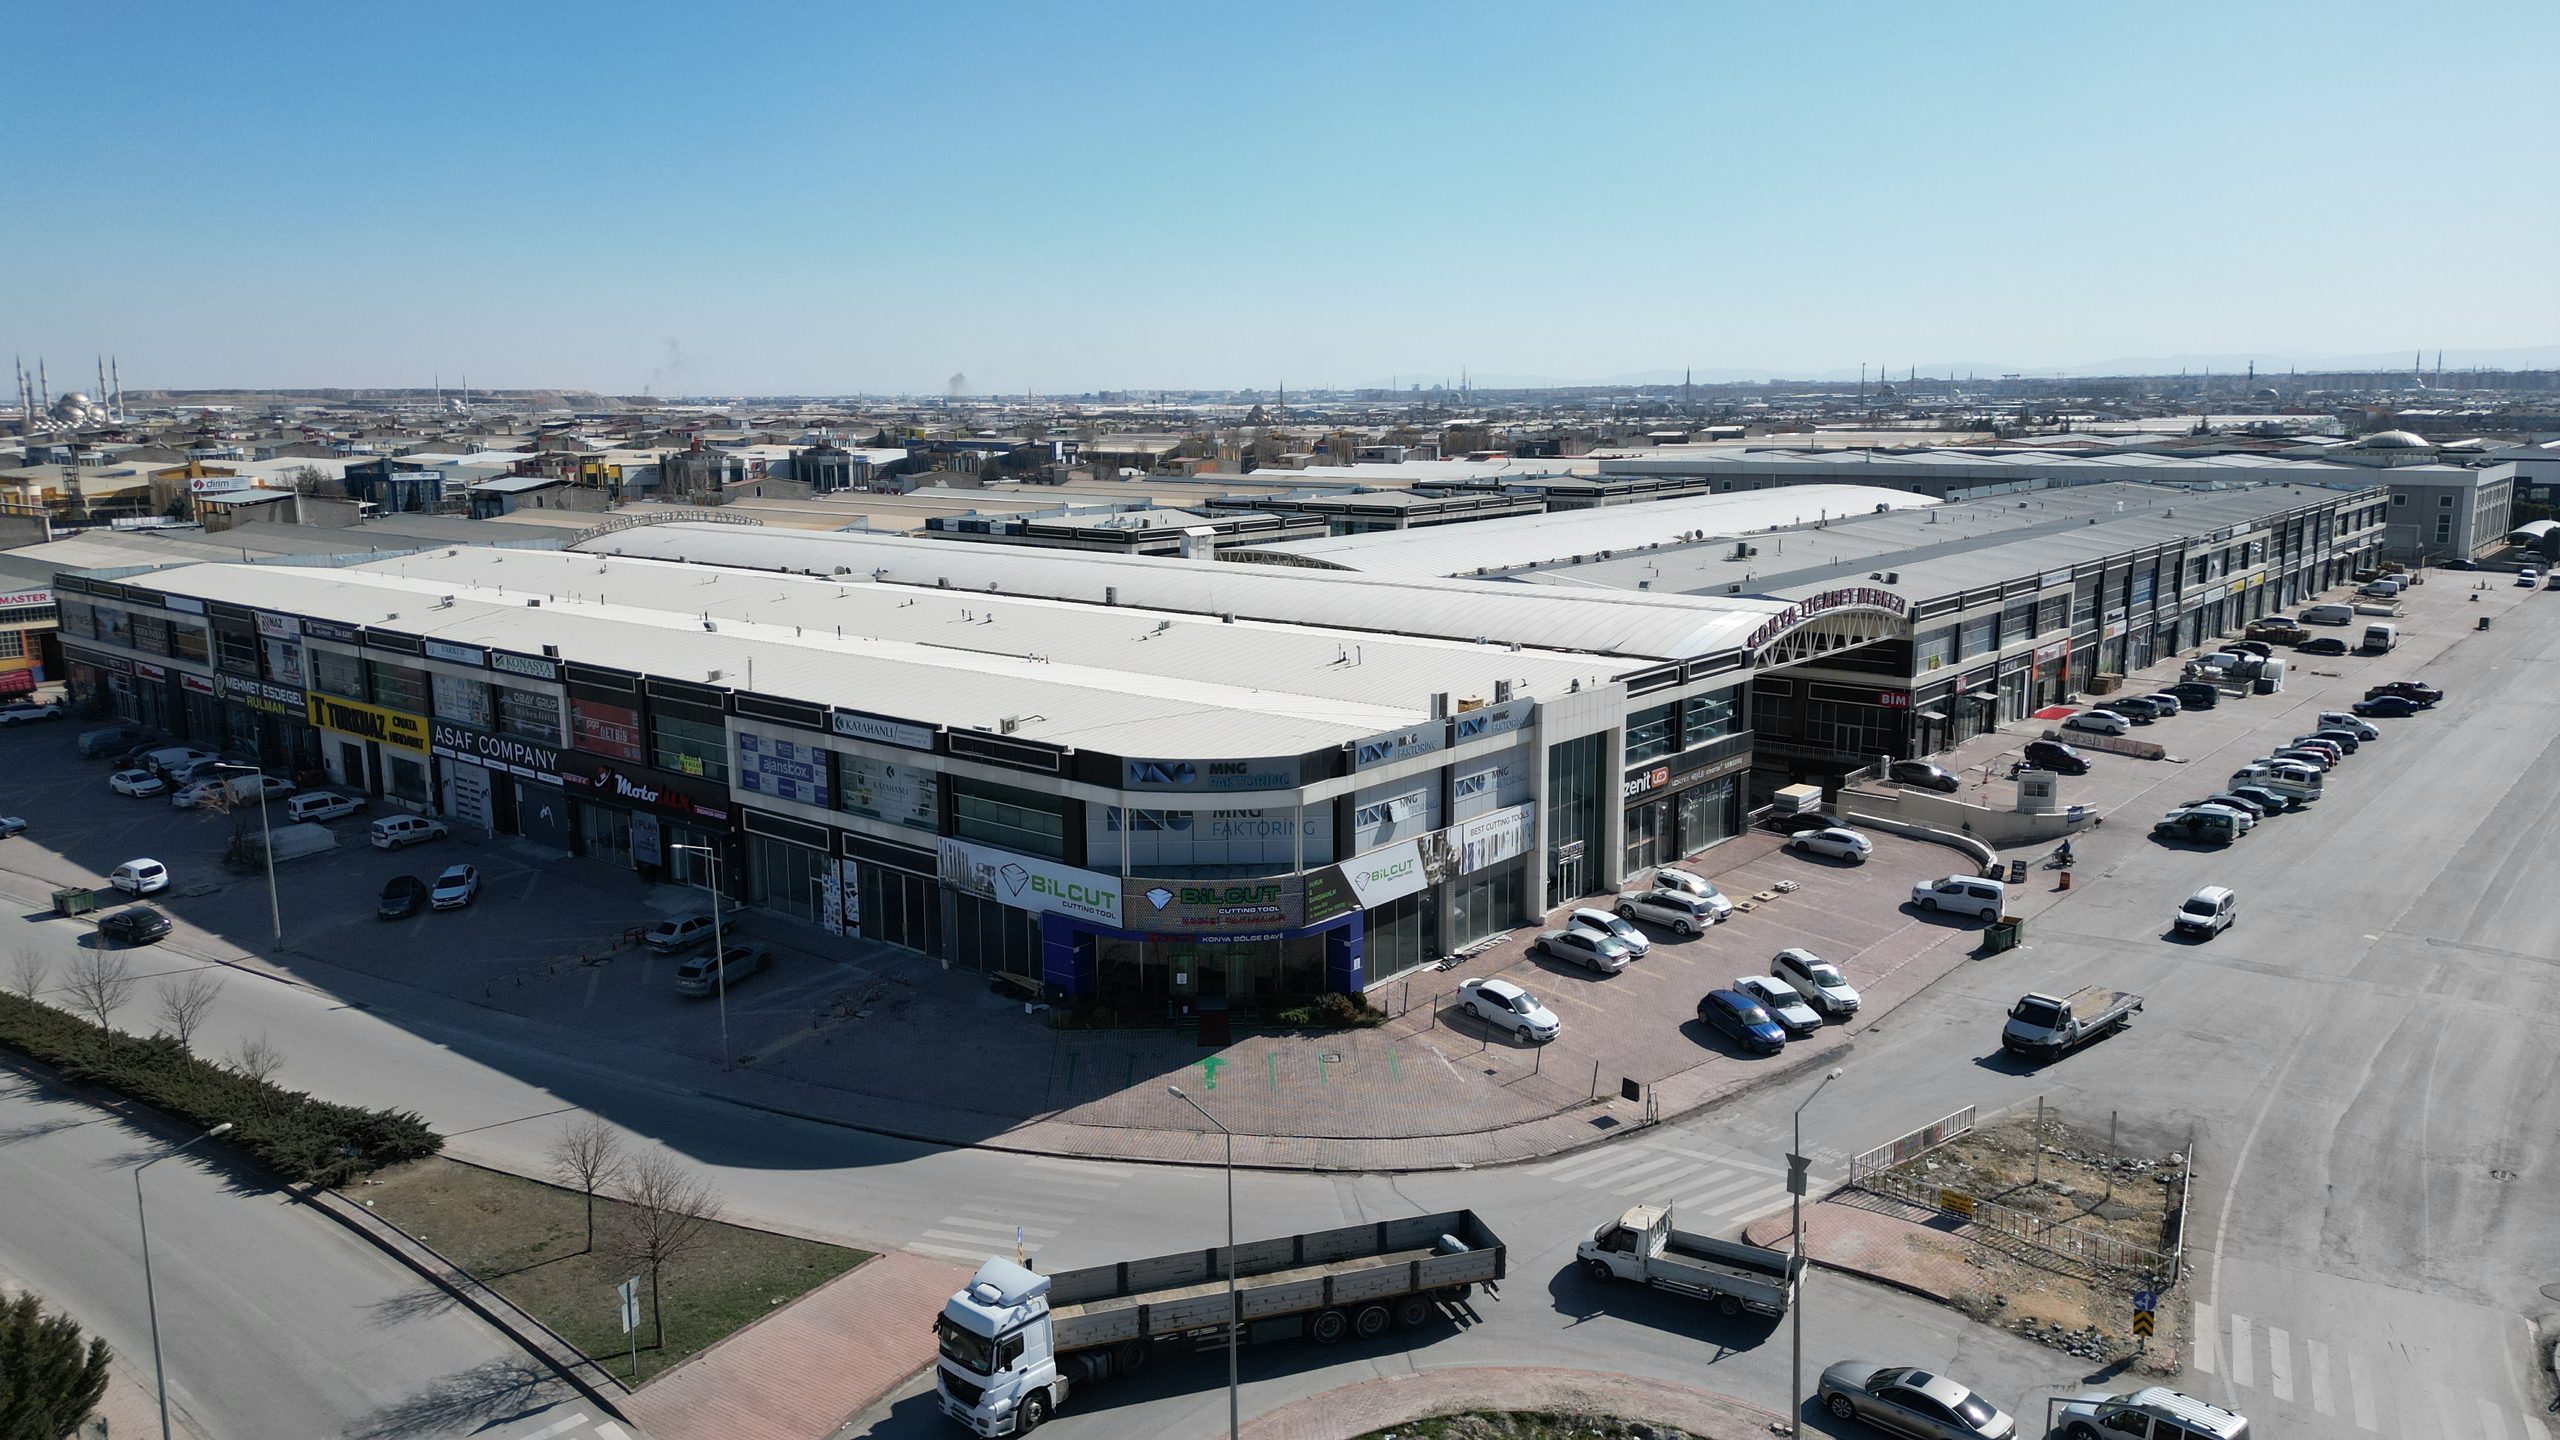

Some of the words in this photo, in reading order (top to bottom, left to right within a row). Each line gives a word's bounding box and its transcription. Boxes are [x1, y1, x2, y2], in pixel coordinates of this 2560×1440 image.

[1747, 606, 1797, 648] KONYA
[506, 656, 551, 674] KONASYA
[225, 676, 260, 696] MEHMET
[246, 696, 286, 716] RULMAN
[1882, 692, 1907, 706] BİM
[435, 725, 473, 750] ASAF
[479, 735, 557, 770] COMPANY
[1398, 733, 1418, 747] MNG
[1209, 762, 1248, 775] MNG
[1492, 766, 1509, 780] MNG
[1208, 772, 1291, 789] FAKTORİNG
[1470, 825, 1485, 837] BEST
[1485, 816, 1511, 833] CUTTING
[1511, 809, 1530, 824] TOOLS
[1062, 901, 1095, 915] CUTTING
[1096, 909, 1117, 920] TOOL
[1218, 907, 1257, 915] CUTTING
[1257, 905, 1280, 914] TOOL
[1202, 935, 1232, 943] KONYA
[1233, 933, 1263, 942] BÖLGE
